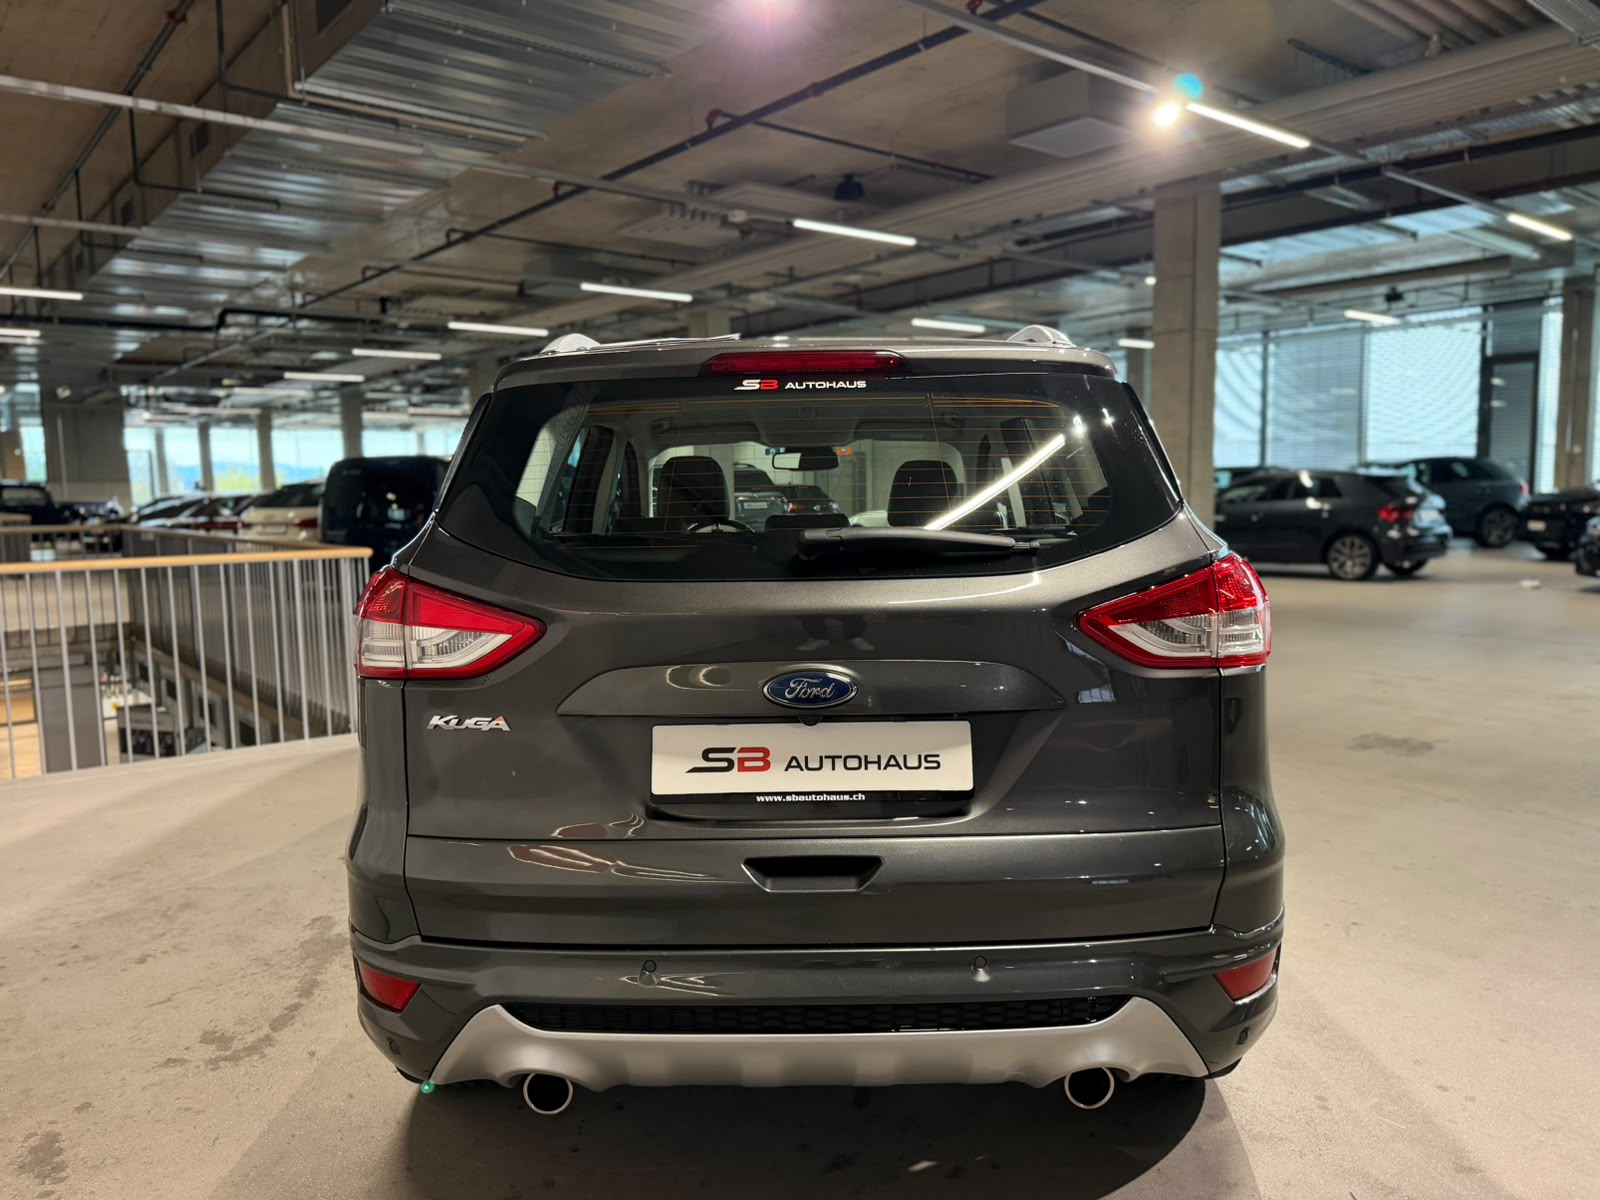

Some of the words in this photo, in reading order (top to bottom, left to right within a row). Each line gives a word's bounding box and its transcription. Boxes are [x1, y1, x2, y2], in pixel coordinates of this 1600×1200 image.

[733, 379, 779, 390] SB
[785, 380, 867, 389] AUTOHAUS
[784, 678, 834, 699] Ford
[427, 715, 511, 731] KUGA
[685, 746, 771, 773] SB
[784, 754, 941, 772] AUTOHAUS
[756, 793, 866, 802] www.sbautohaus.ch
